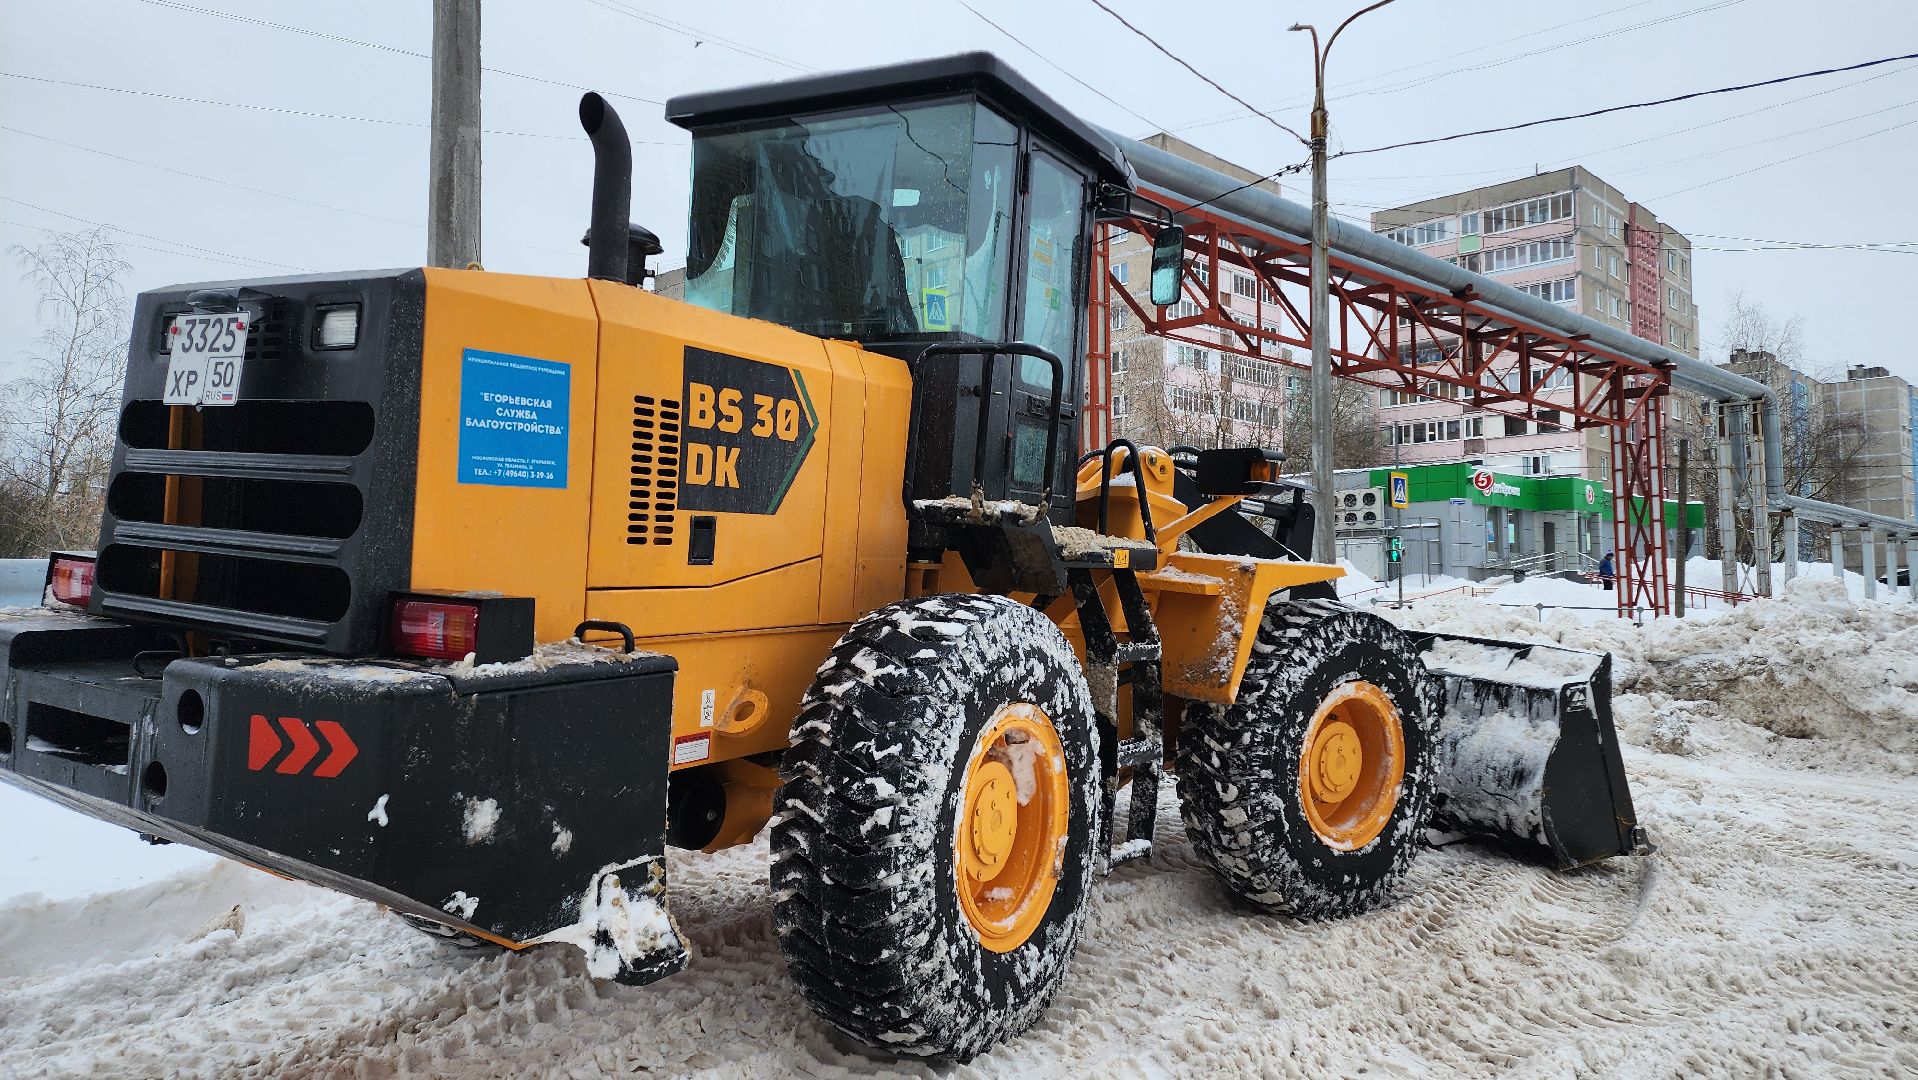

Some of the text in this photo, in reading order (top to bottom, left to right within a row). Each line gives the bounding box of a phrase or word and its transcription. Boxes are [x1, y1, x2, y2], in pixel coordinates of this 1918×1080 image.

[181, 317, 239, 353] 3325
[211, 362, 235, 387] 50
[204, 390, 222, 401] RUS
[495, 407, 538, 421] СЛУЖБА
[689, 381, 800, 442] BS 30
[502, 470, 529, 479] (49640)
[686, 442, 741, 489] DK
